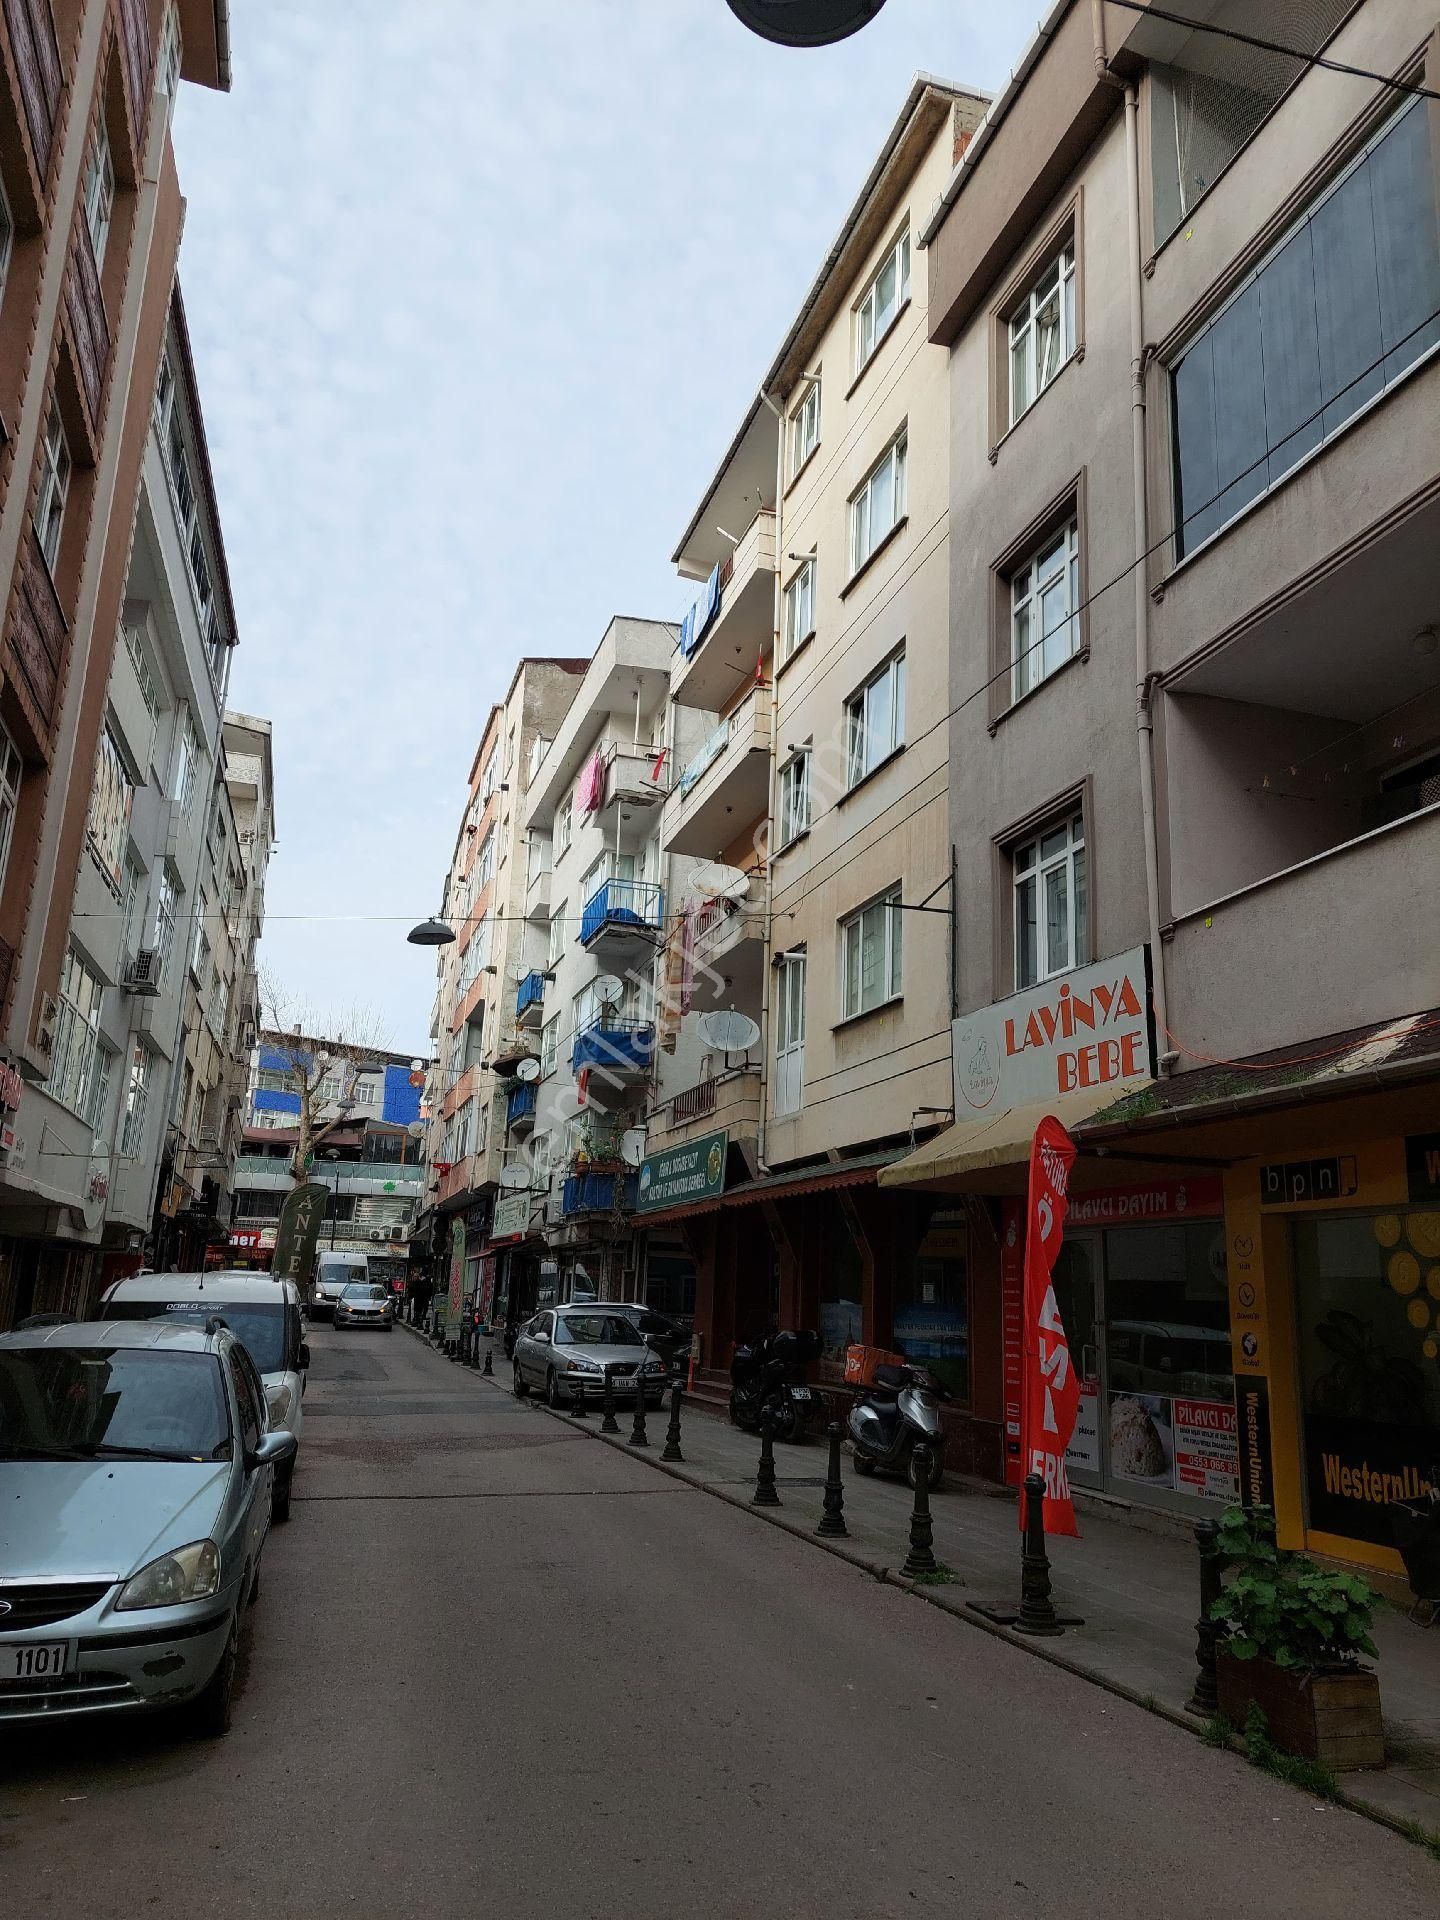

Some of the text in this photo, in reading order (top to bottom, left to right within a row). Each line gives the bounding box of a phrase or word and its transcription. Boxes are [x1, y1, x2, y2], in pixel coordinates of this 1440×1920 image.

[1005, 976, 1143, 1057] LAVİNYA
[1057, 1030, 1146, 1094] BEBE
[1119, 1191, 1168, 1217] DAYIM
[1178, 1403, 1219, 1428] PİLAVCI
[1245, 1391, 1262, 1504] WesternUnion
[16, 1647, 61, 1676] 1101
